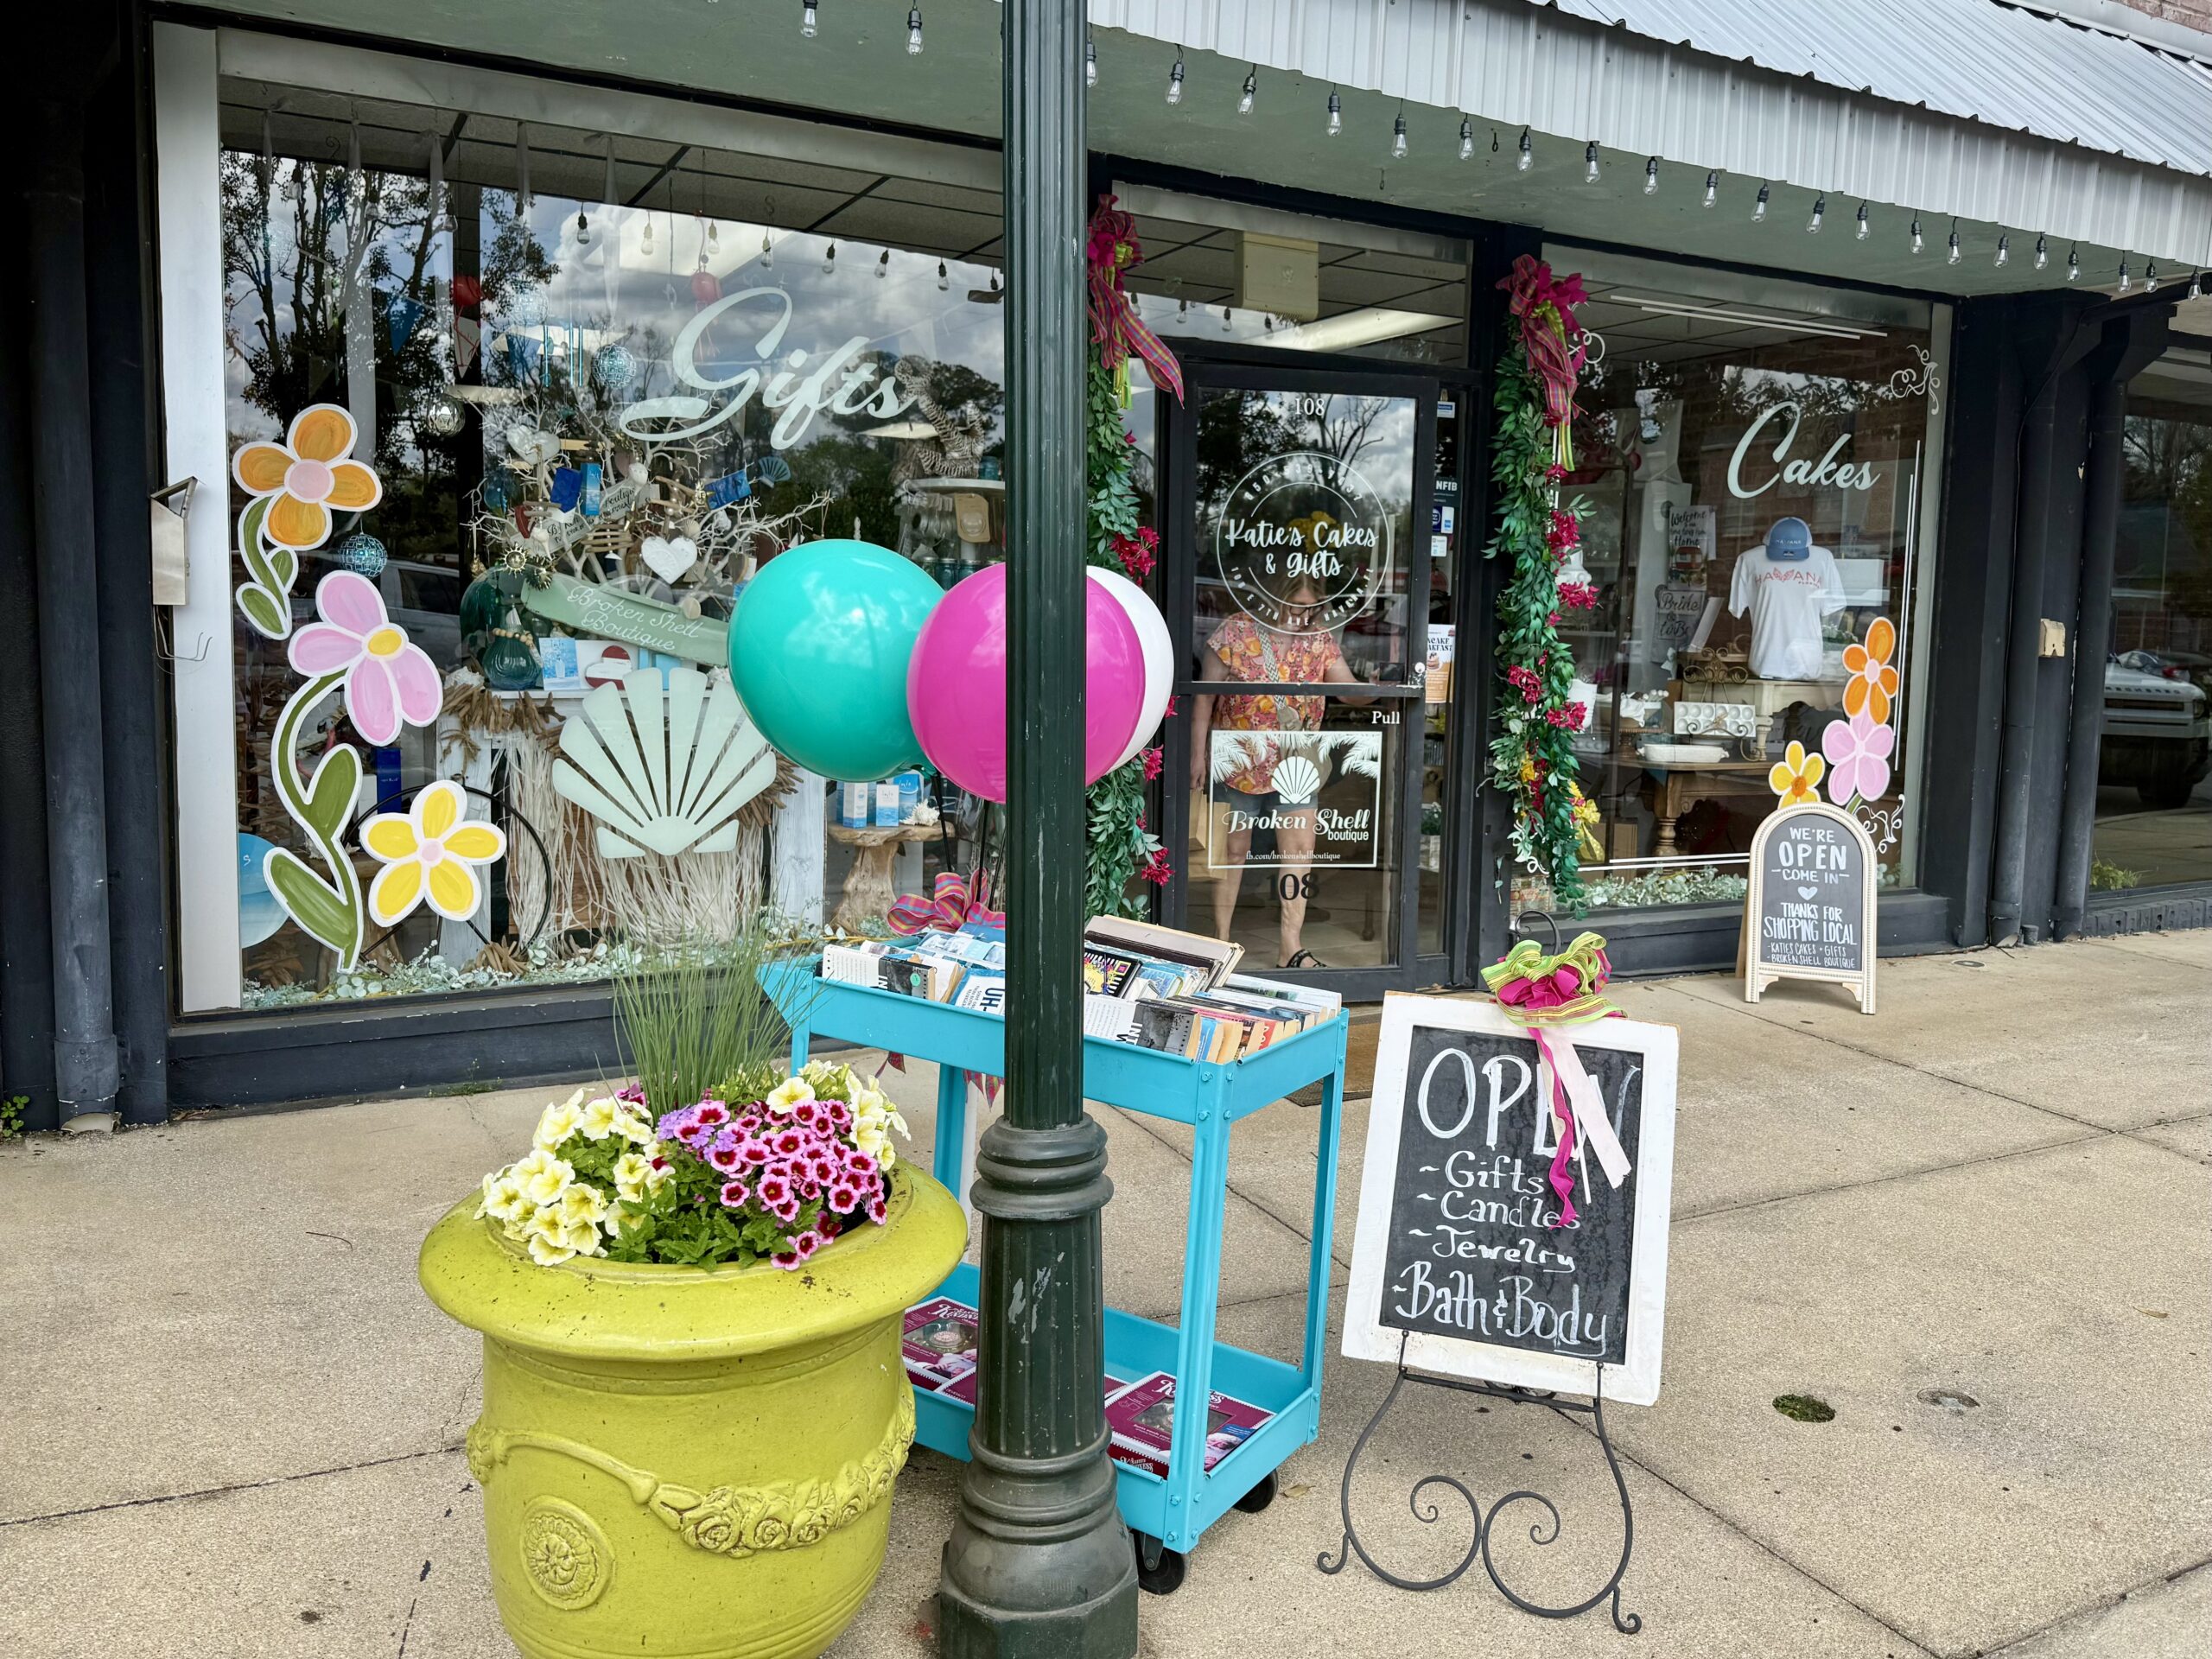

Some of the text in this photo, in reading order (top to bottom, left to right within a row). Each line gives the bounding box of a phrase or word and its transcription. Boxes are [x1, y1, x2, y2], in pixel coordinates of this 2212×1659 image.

[619, 286, 918, 450] Gifts
[1294, 397, 1325, 417] 108
[1726, 401, 1880, 499] Cakes
[1670, 511, 1707, 527] Welcome
[1224, 518, 1380, 549] Katie's Cakes
[1266, 552, 1276, 575] &
[566, 584, 702, 639] Broken Shell
[1257, 603, 1280, 621] 7TH
[1662, 592, 1700, 612] Bride
[581, 610, 677, 652] Boutique
[1371, 710, 1401, 725] Pull
[1222, 808, 1371, 836] Broken Shell
[1327, 827, 1370, 843] boutique
[1789, 827, 1835, 842] WE'RE
[1246, 850, 1341, 861] fb.com/brokenshellboutique
[1778, 841, 1847, 870] OPEN
[1782, 868, 1839, 884] COME IN
[1266, 873, 1319, 901] 108
[1780, 902, 1843, 922] THANKS FOR
[1763, 916, 1859, 946] SHOPPING LOCAL
[1795, 943, 1816, 955] CAKES
[1824, 945, 1847, 957] GIFTS
[1799, 955, 1821, 965] SHELL
[1823, 957, 1855, 969] BOUTIQUE
[1492, 1288, 1509, 1329] &
[1500, 1275, 1607, 1357] Body
